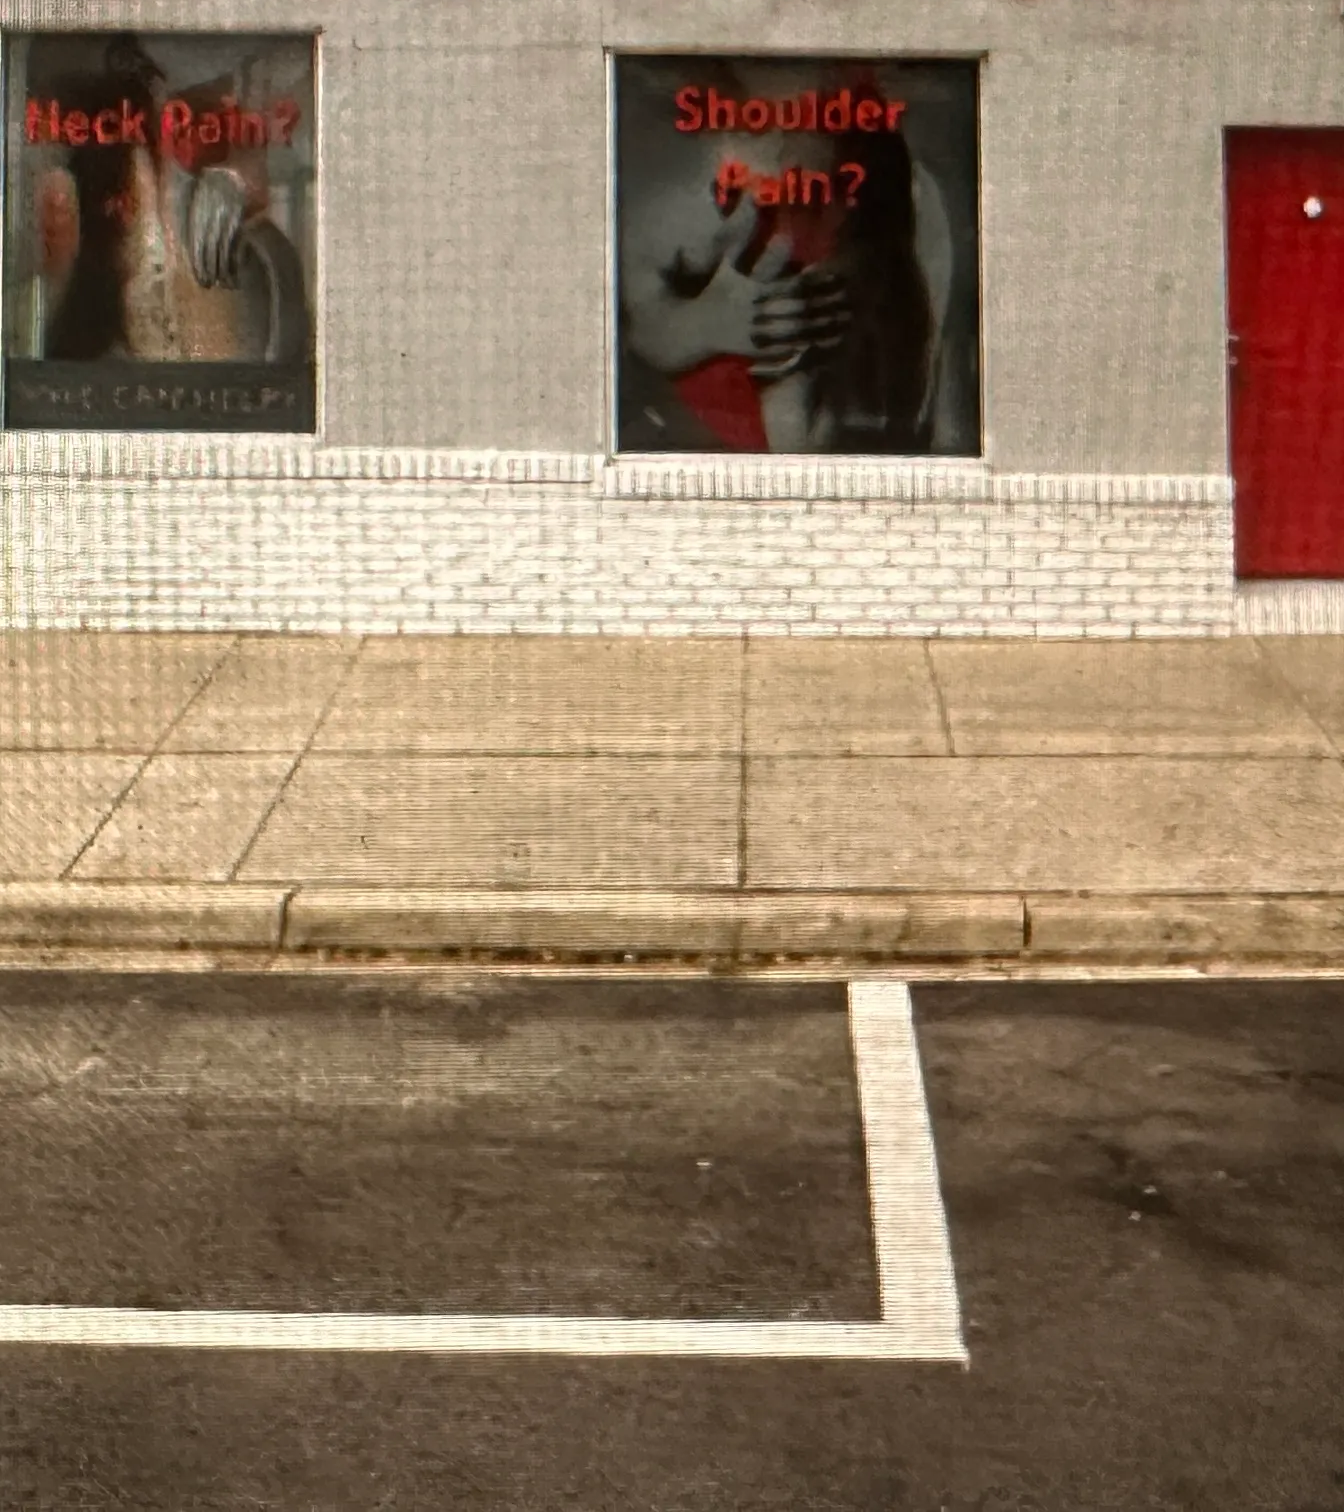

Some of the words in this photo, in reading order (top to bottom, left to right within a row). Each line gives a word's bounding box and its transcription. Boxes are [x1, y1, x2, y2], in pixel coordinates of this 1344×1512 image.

[24, 97, 148, 146] Neck
[160, 98, 301, 150] Pain?
[673, 85, 907, 133] Shoulder
[714, 157, 867, 208] Pain?
